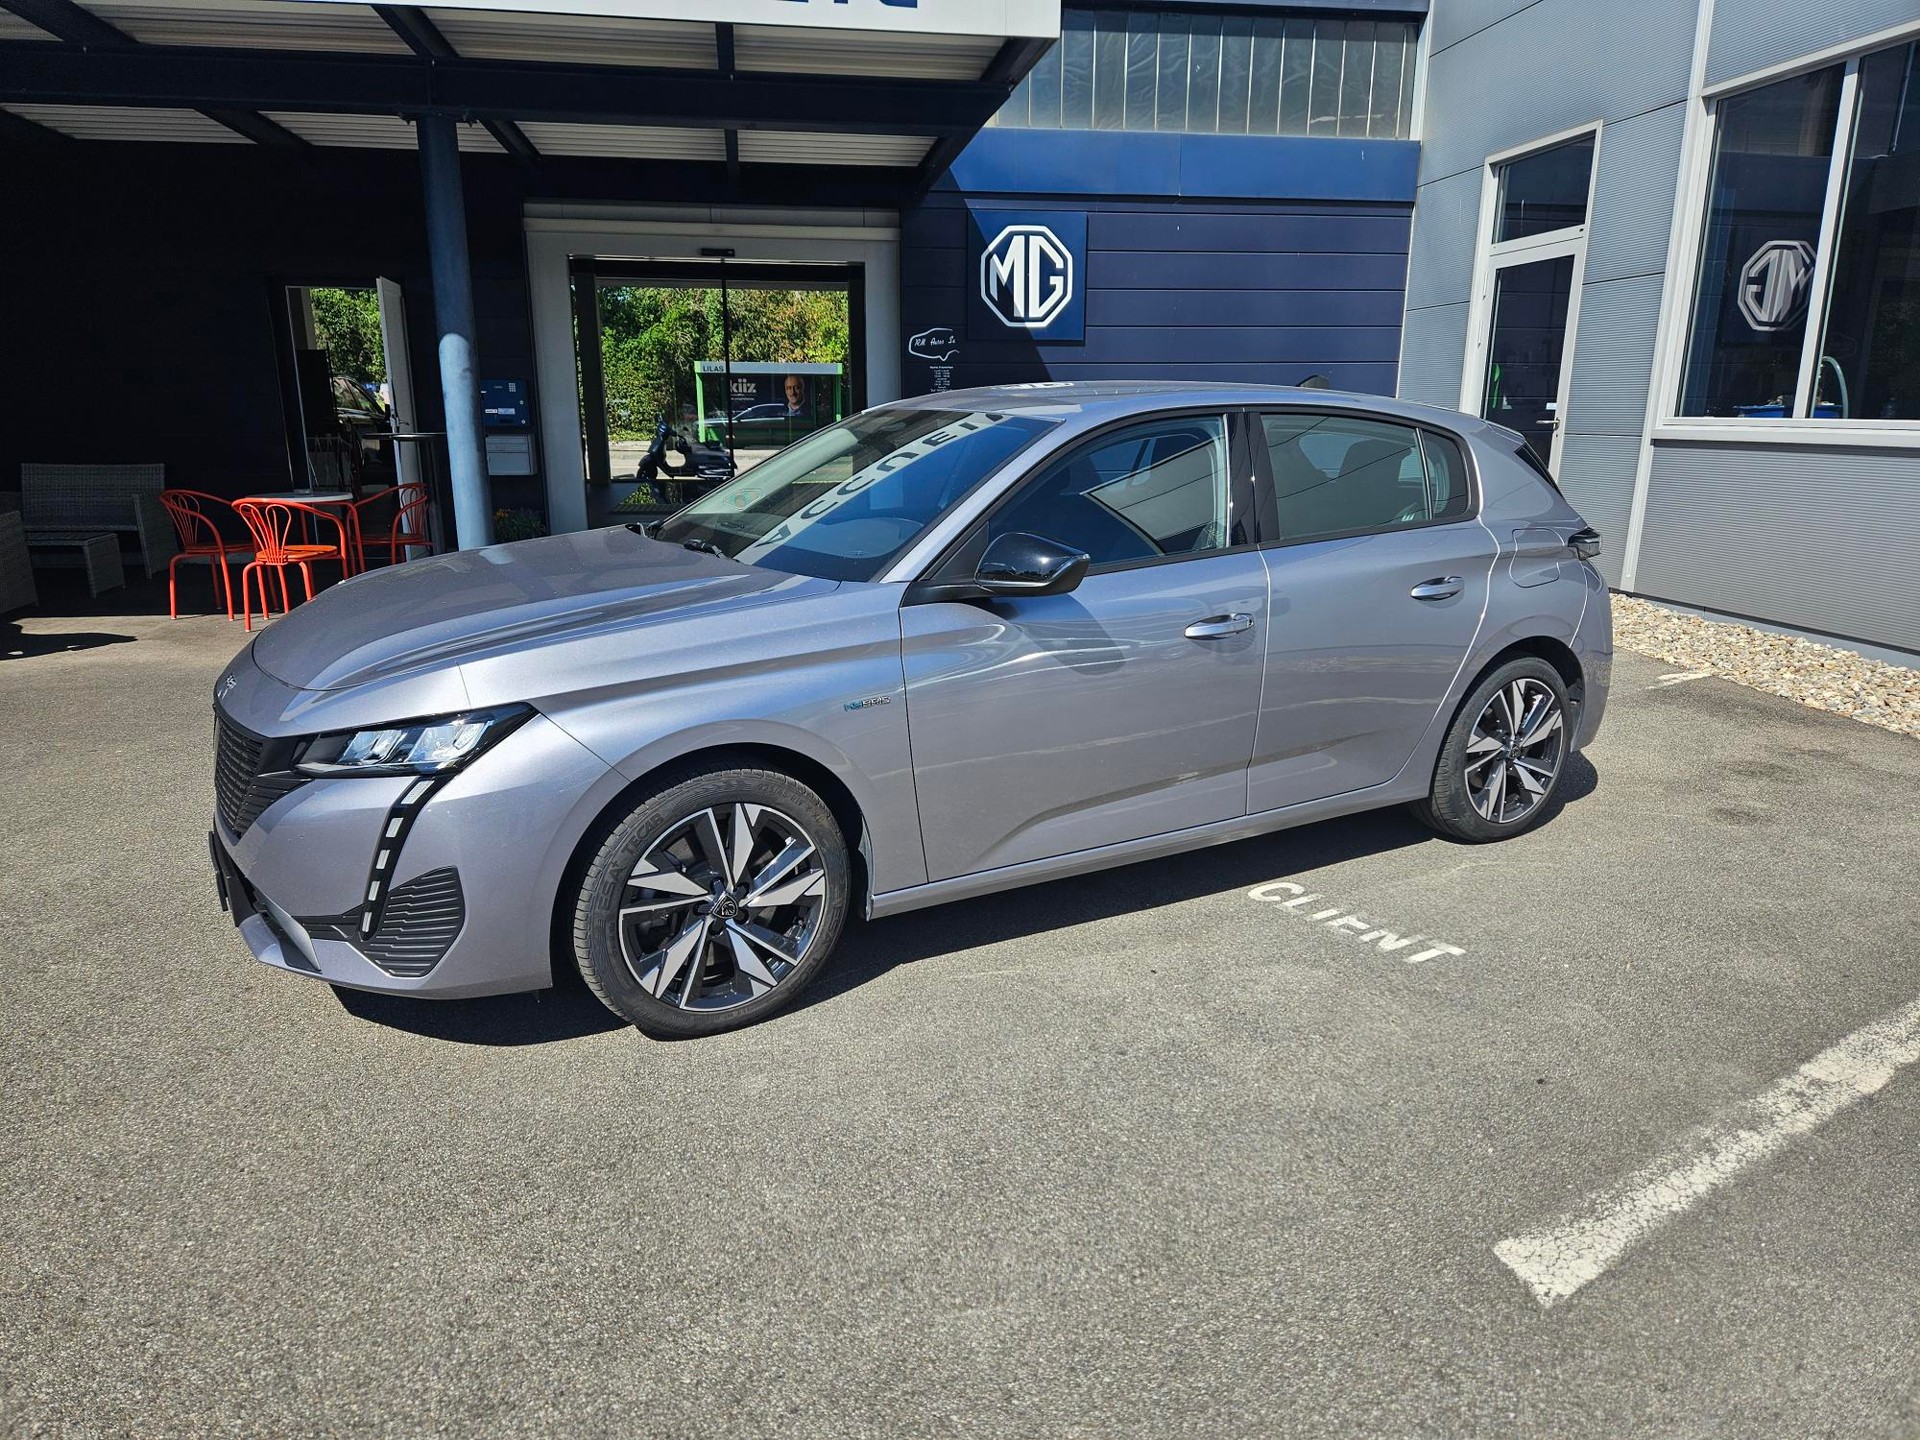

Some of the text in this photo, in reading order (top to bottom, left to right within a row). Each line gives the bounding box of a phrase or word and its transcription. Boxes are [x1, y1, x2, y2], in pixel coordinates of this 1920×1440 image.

[990, 235, 1064, 318] MG
[703, 365, 724, 373] LILAS
[1248, 882, 1467, 964] CLIENT
